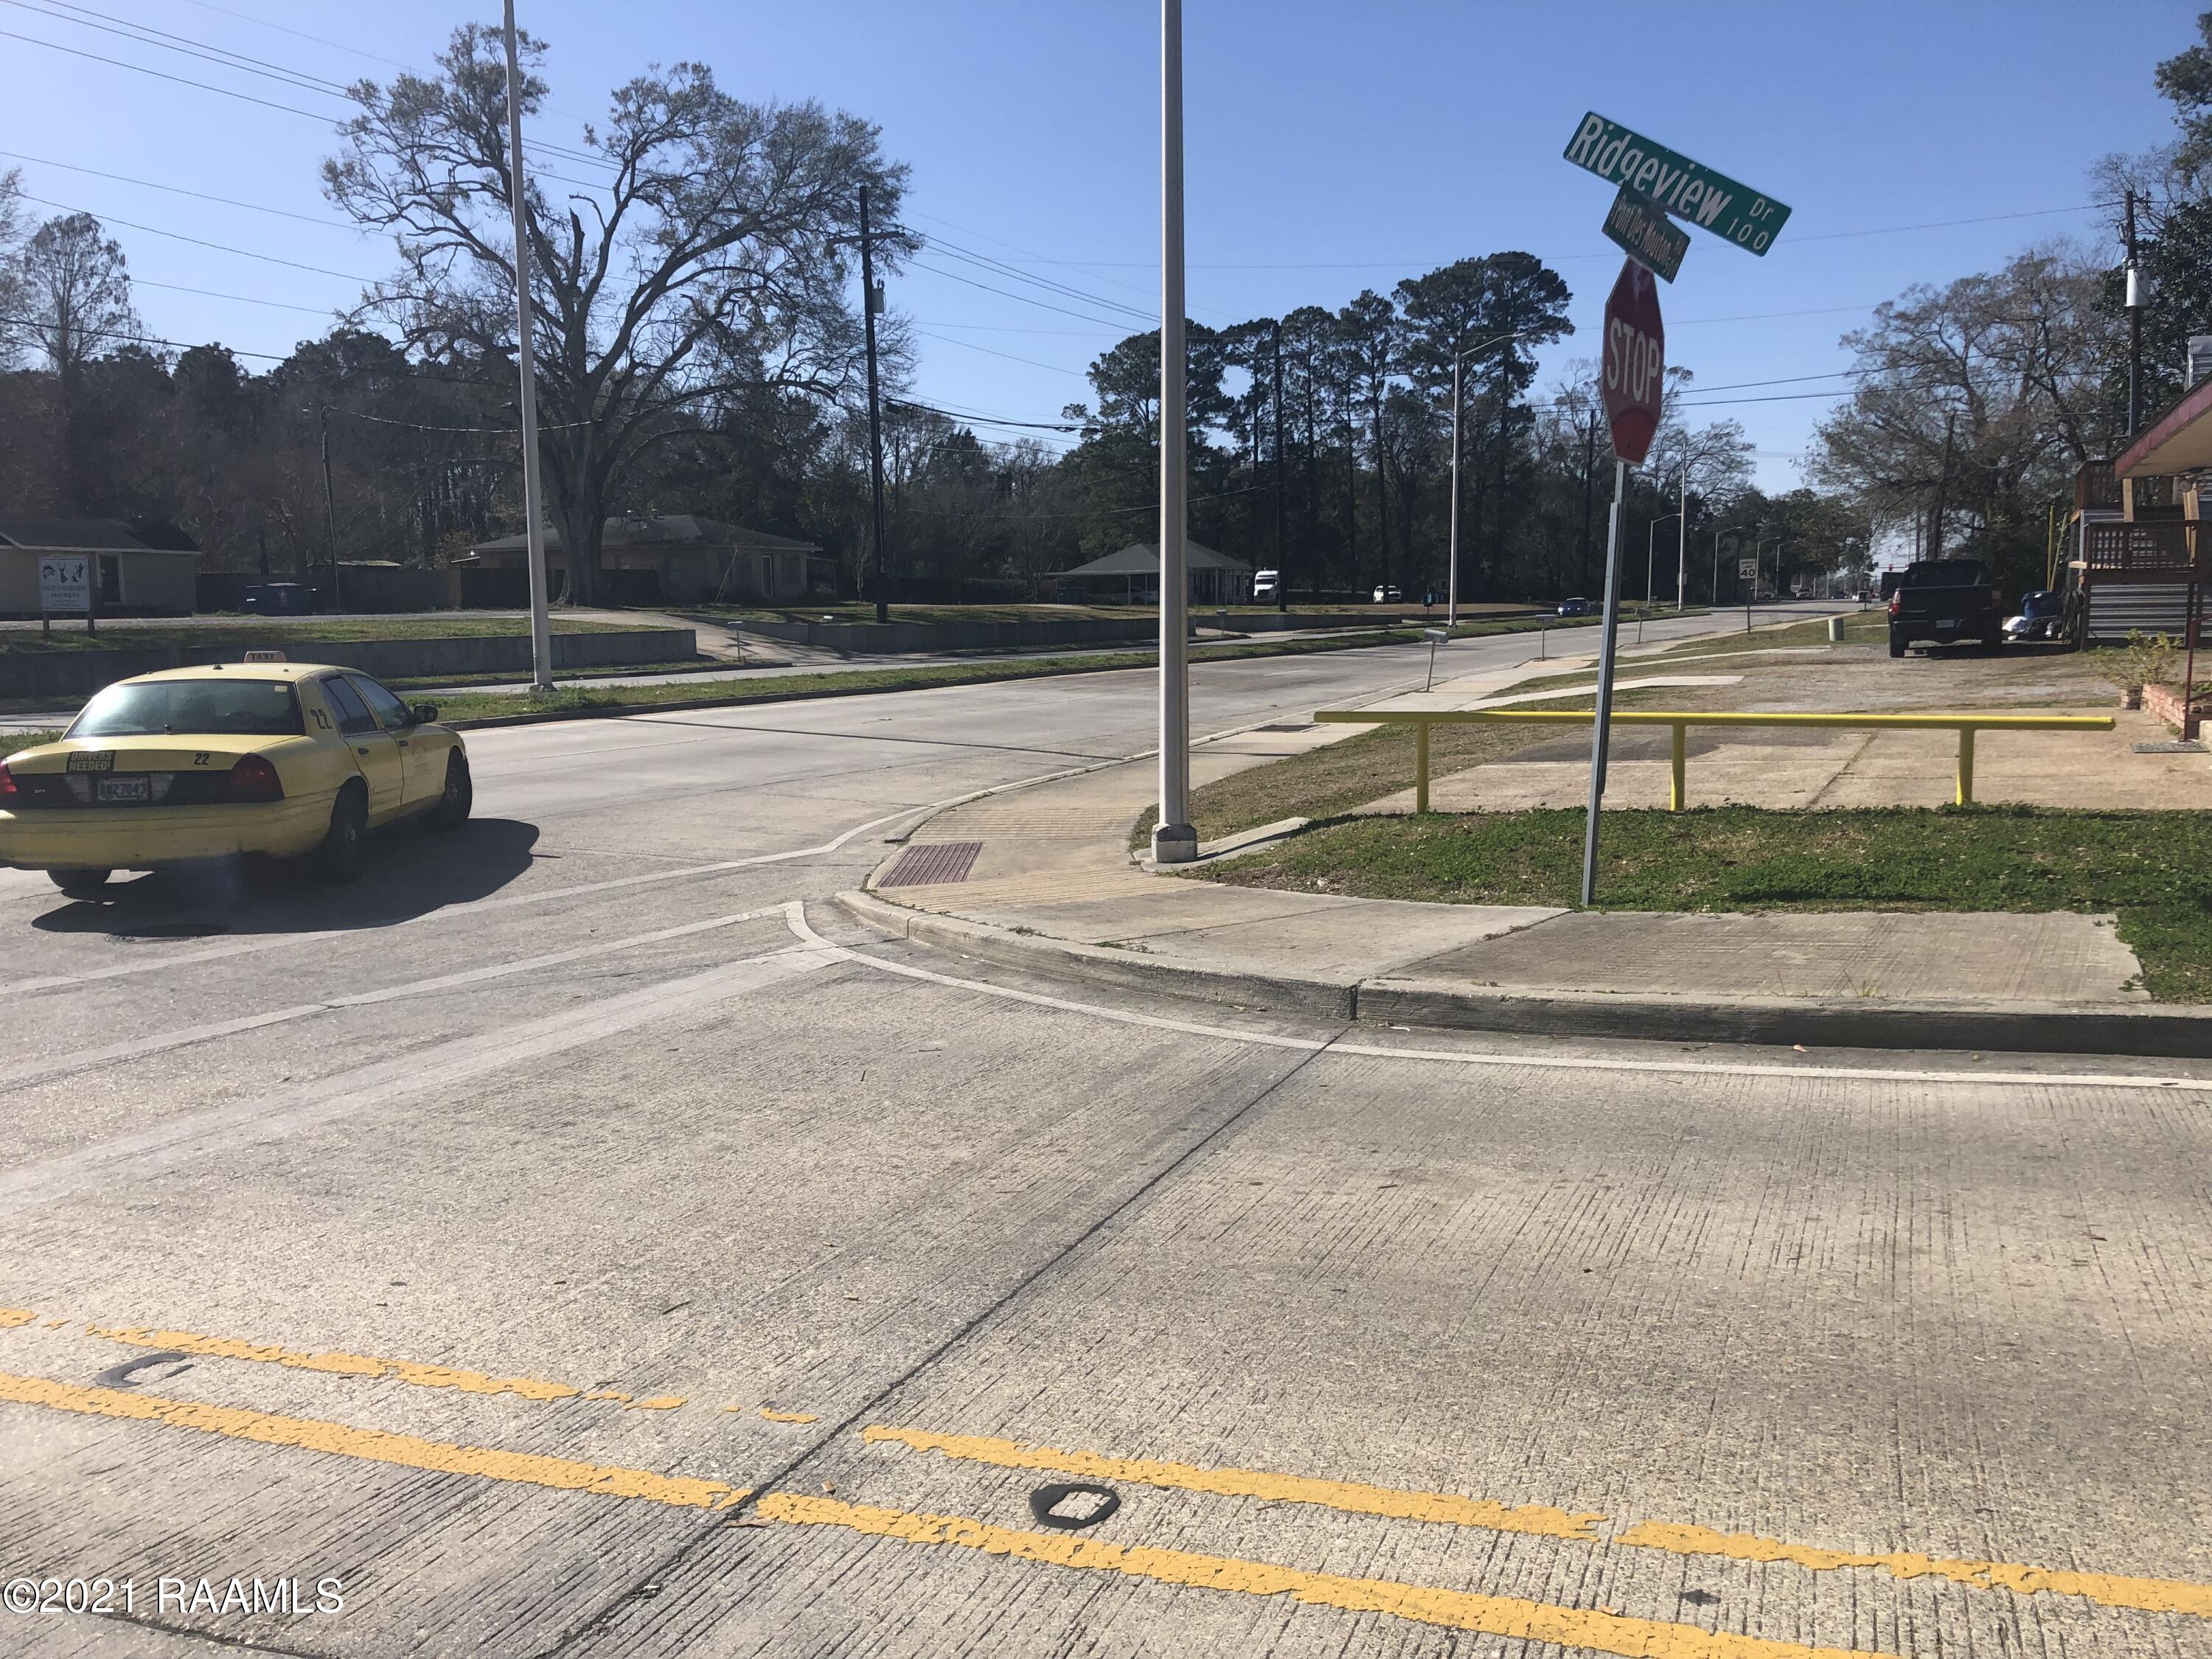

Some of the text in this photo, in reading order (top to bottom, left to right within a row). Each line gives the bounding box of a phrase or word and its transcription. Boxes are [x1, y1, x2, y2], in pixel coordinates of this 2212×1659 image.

[1566, 114, 1774, 226] Ridgeview Dr
[1610, 193, 1636, 235] Pont
[1627, 207, 1646, 246] Des
[1640, 220, 1672, 266] Mouton
[1727, 218, 1770, 251] 100
[1607, 317, 1659, 404] STOP
[310, 709, 333, 729] 22
[71, 751, 112, 760] DRIVERS
[194, 753, 210, 765] 22
